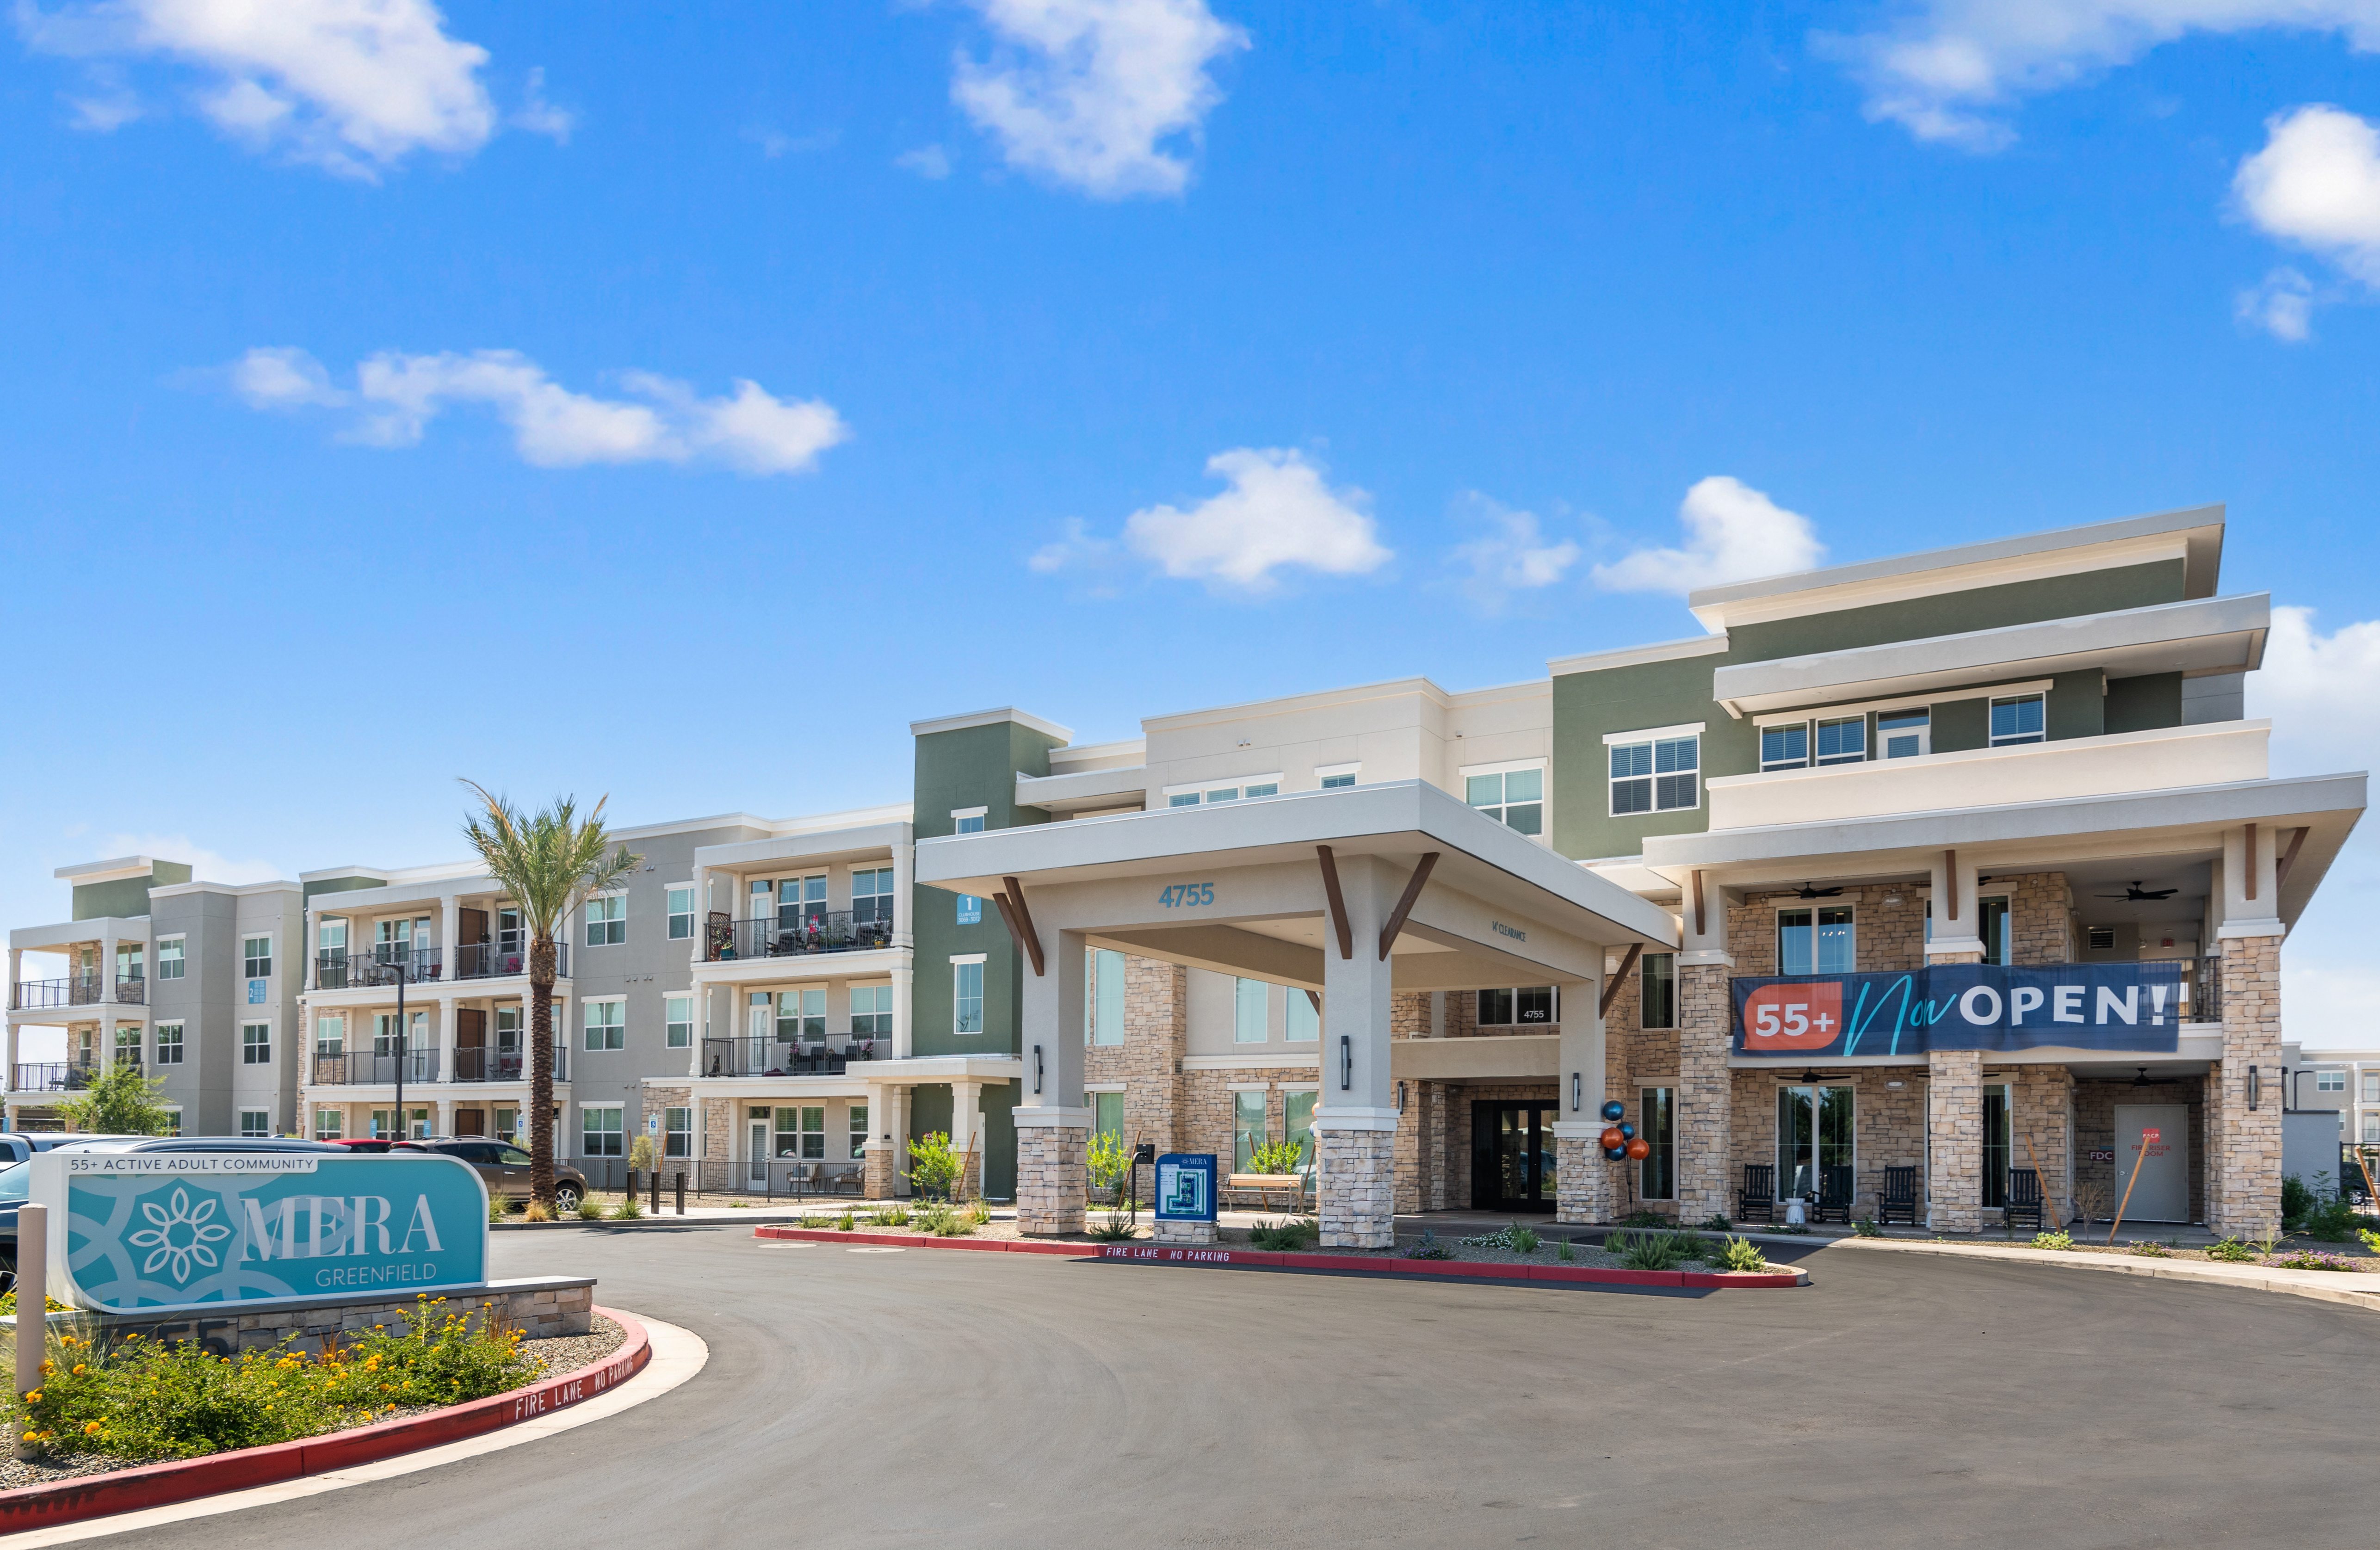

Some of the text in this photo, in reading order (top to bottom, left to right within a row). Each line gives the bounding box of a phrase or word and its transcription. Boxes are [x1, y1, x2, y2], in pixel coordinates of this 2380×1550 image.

[967, 897, 971, 910] 1
[1158, 883, 1214, 908] 4755
[1499, 924, 1526, 942] CLEARANCE
[249, 988, 253, 997] 2
[1756, 975, 2168, 1056] 55+ Now OPEN!
[71, 1159, 313, 1170] 55+ ACTIVE ADULT COMMUNITY
[237, 1194, 445, 1261] MERA
[1107, 1247, 1230, 1261] FIRE LANE NO PARKING
[315, 1263, 437, 1287] GREENFIELD
[515, 1357, 633, 1420] FIRE LANE NO PARKING
